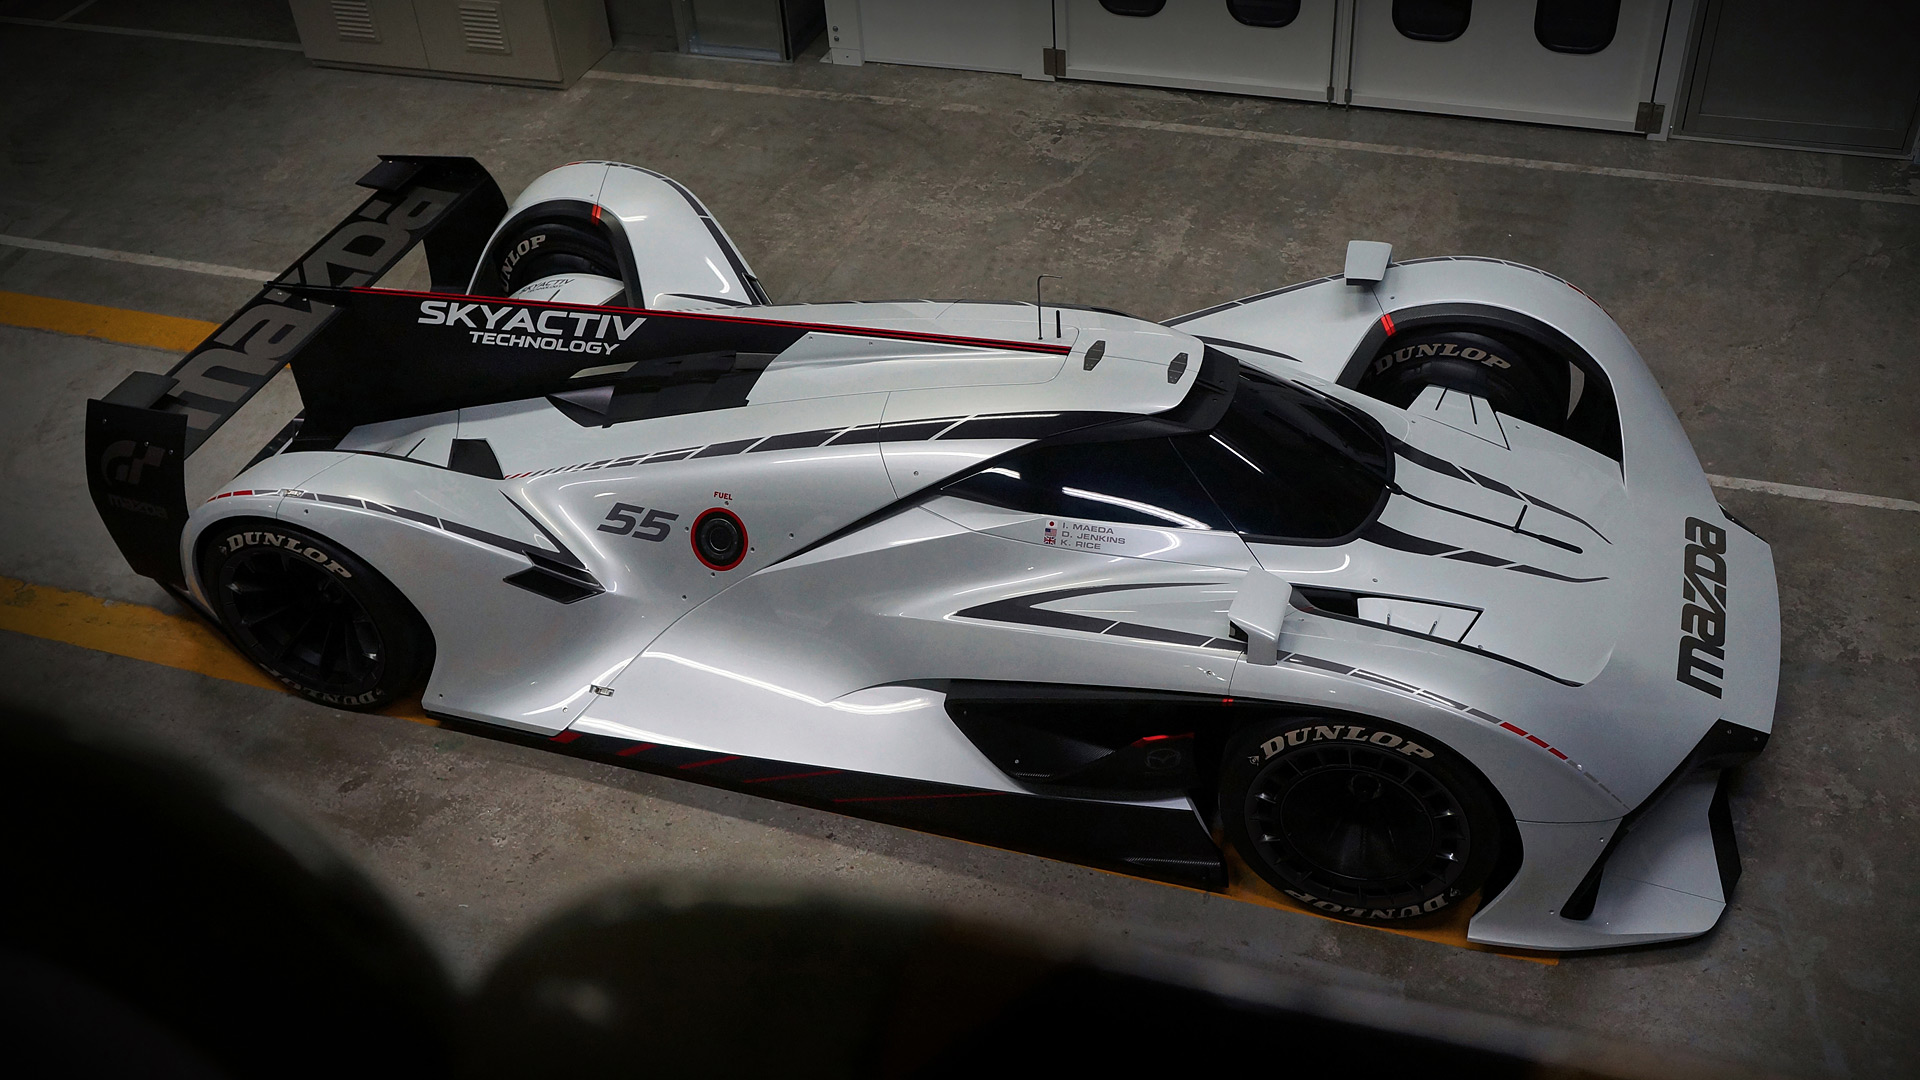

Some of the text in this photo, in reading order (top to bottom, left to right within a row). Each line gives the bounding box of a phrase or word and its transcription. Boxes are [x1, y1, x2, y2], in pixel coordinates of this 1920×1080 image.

[500, 234, 546, 293] UNLOP
[417, 300, 648, 341] SKYACTIV
[469, 331, 621, 356] TECHNOLOGY
[1373, 343, 1512, 375] DUNLOP
[713, 491, 733, 501] FUEL
[597, 502, 680, 543] 55
[1061, 531, 1126, 545] D. JENKINS
[1062, 522, 1114, 535] I. MAEDA
[226, 531, 353, 578] DUNLOP
[1060, 539, 1102, 550] K. RICE
[1676, 516, 1728, 700] mazda
[1260, 725, 1435, 761] DUNLOP
[1283, 889, 1449, 920] DUNLOP
